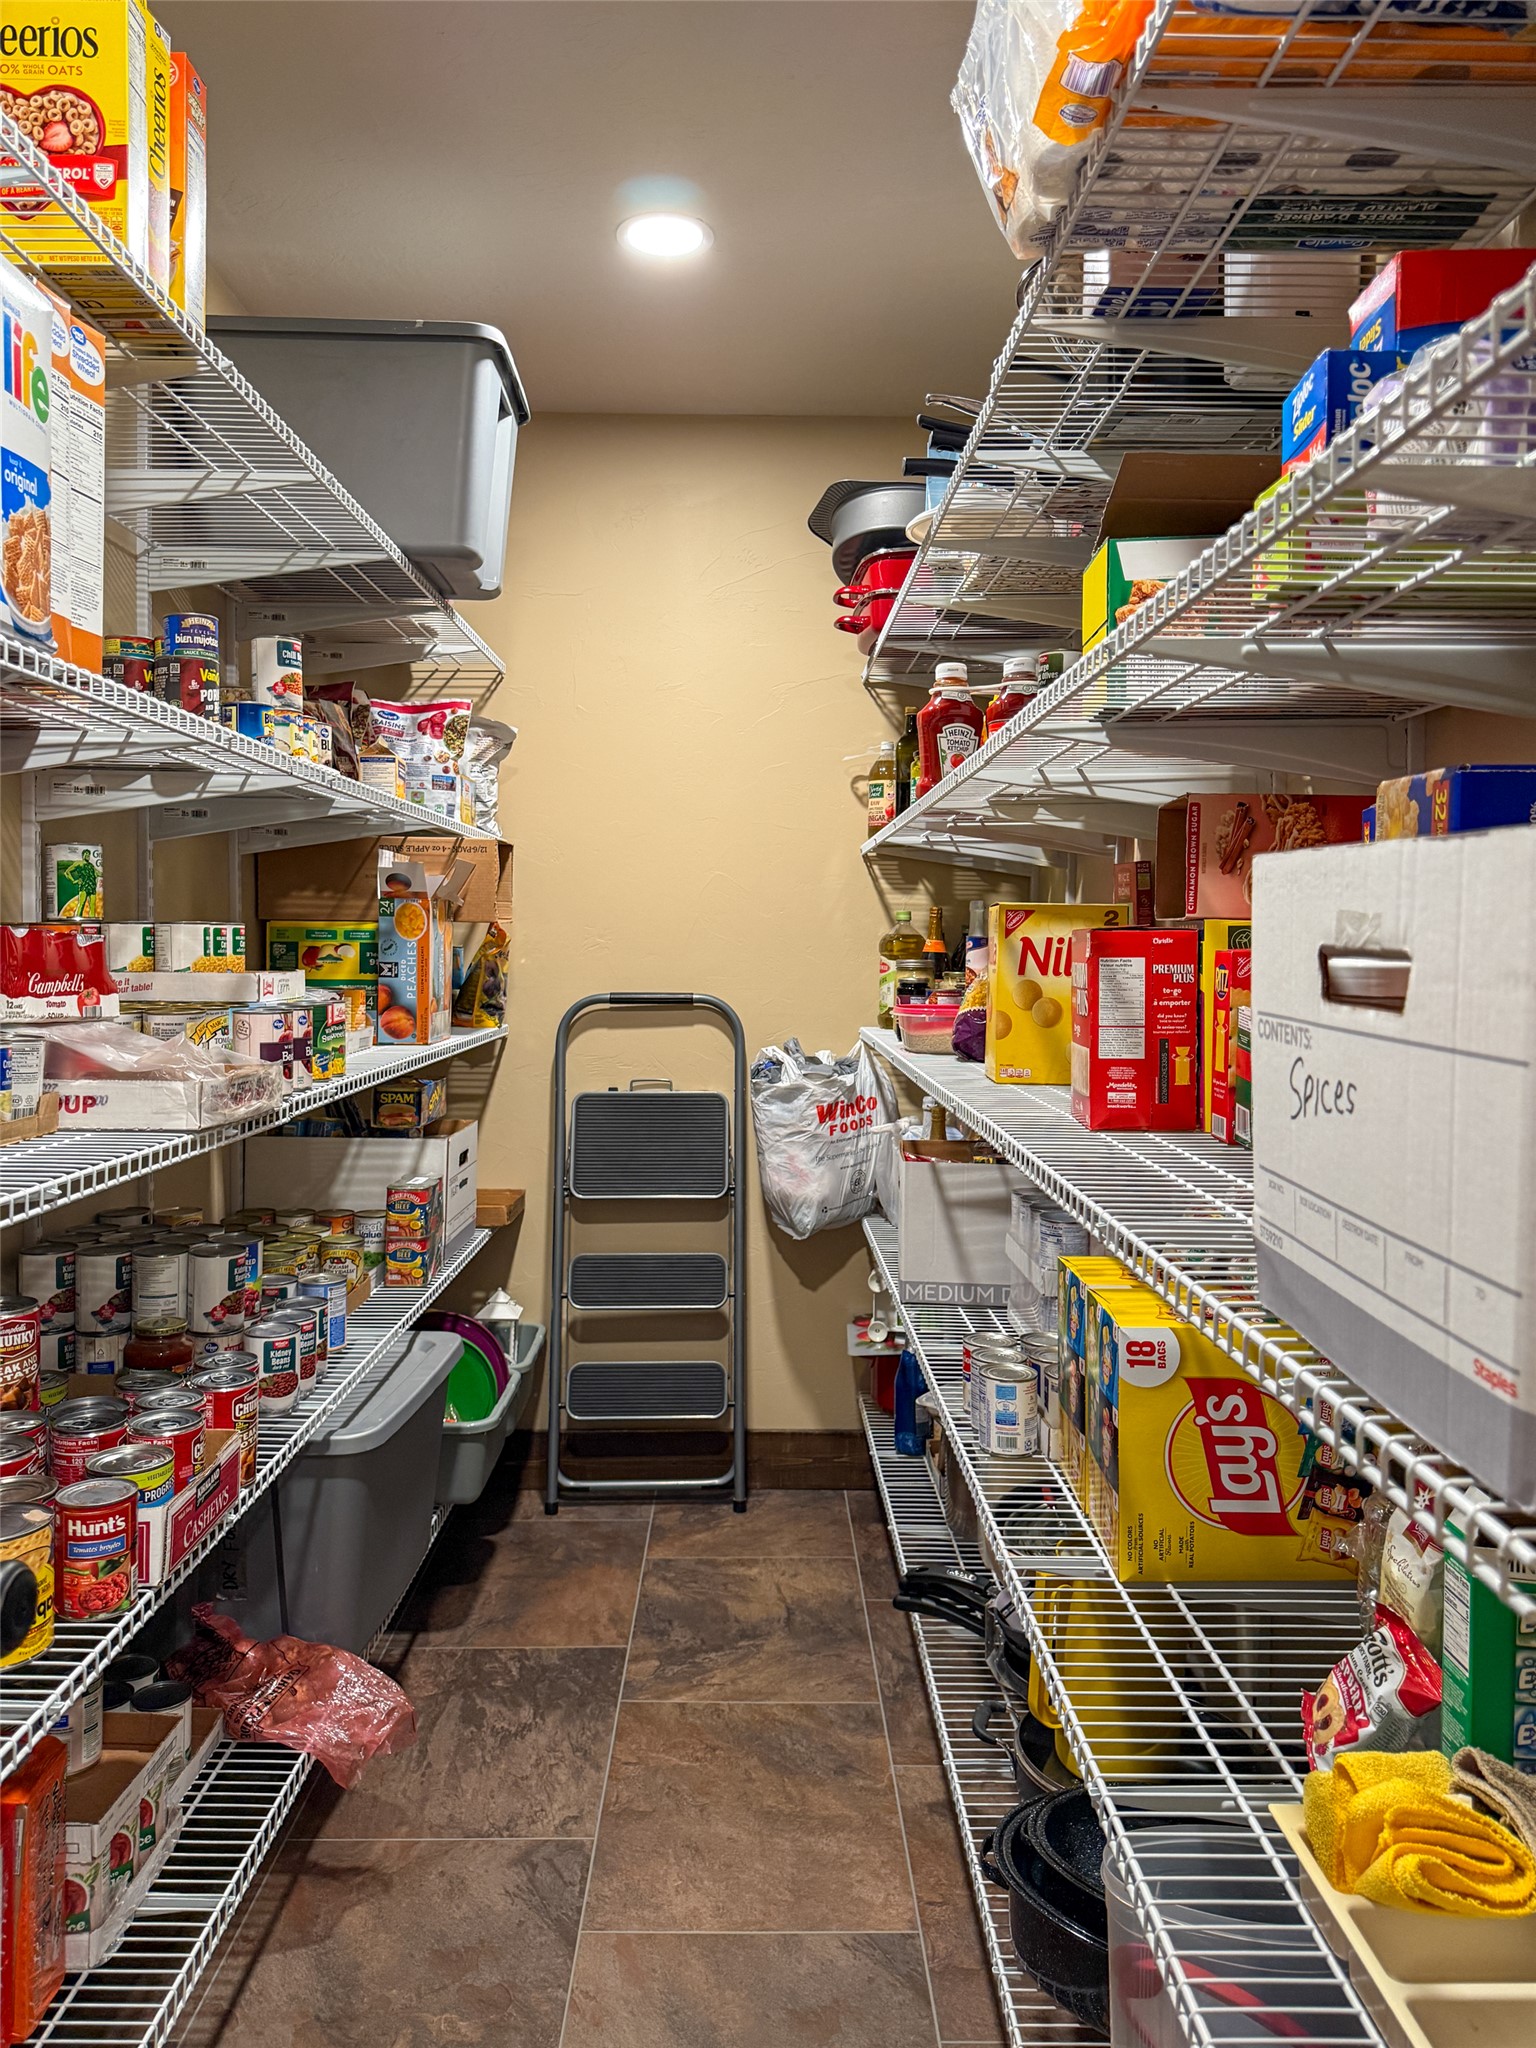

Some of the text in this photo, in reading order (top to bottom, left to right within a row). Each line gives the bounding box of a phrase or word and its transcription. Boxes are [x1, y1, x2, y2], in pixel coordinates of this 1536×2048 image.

[48, 66, 83, 76] OATS
[149, 67, 167, 180] Cheerios
[3, 310, 50, 424] life
[71, 349, 100, 375] Shredded
[70, 393, 89, 411] utrition
[1293, 405, 1317, 442] Slider
[93, 429, 103, 440] 210
[4, 466, 38, 498] original
[188, 617, 214, 629] HEINZ
[948, 729, 970, 738] HEINZ
[946, 739, 971, 748] TOMATO
[1435, 789, 1447, 821] 32
[406, 845, 431, 853] APPLE
[1118, 872, 1130, 882] RICE
[1188, 866, 1196, 911] CINNAMON
[380, 900, 390, 914] 24
[1104, 910, 1119, 926] 2
[407, 941, 418, 999] PEACHES
[1152, 964, 1195, 974] PREMIUM
[28, 971, 84, 996] Campbell's
[124, 978, 129, 986] it
[1172, 973, 1195, 983] PLUS
[1215, 967, 1229, 993] RITZ
[117, 983, 153, 993] our table!
[1162, 987, 1182, 996] to-go
[6, 1000, 14, 1009] 12
[45, 1000, 66, 1008] Tomato
[1159, 1000, 1191, 1008] emporter
[1257, 1018, 1313, 1051] CONTENTS:
[58, 1095, 97, 1114] UP
[380, 1092, 414, 1104] SPAM
[816, 1095, 877, 1124] WinCo
[829, 1115, 873, 1136] FOODS
[905, 1284, 993, 1302] MEDIUM
[23, 1354, 38, 1367] AND
[270, 1348, 292, 1358] Kidney
[1125, 1340, 1157, 1369] 18
[1157, 1340, 1167, 1369] BAGS
[271, 1357, 291, 1366] Beans
[1473, 1357, 1518, 1399] Staples
[1194, 1394, 1282, 1515] Lay's
[183, 1485, 230, 1549] CASHEWS
[68, 1515, 126, 1537] Hunt's
[73, 1544, 98, 1554] Tomates
[1154, 1540, 1158, 1550] NO
[1128, 1552, 1133, 1562] NO
